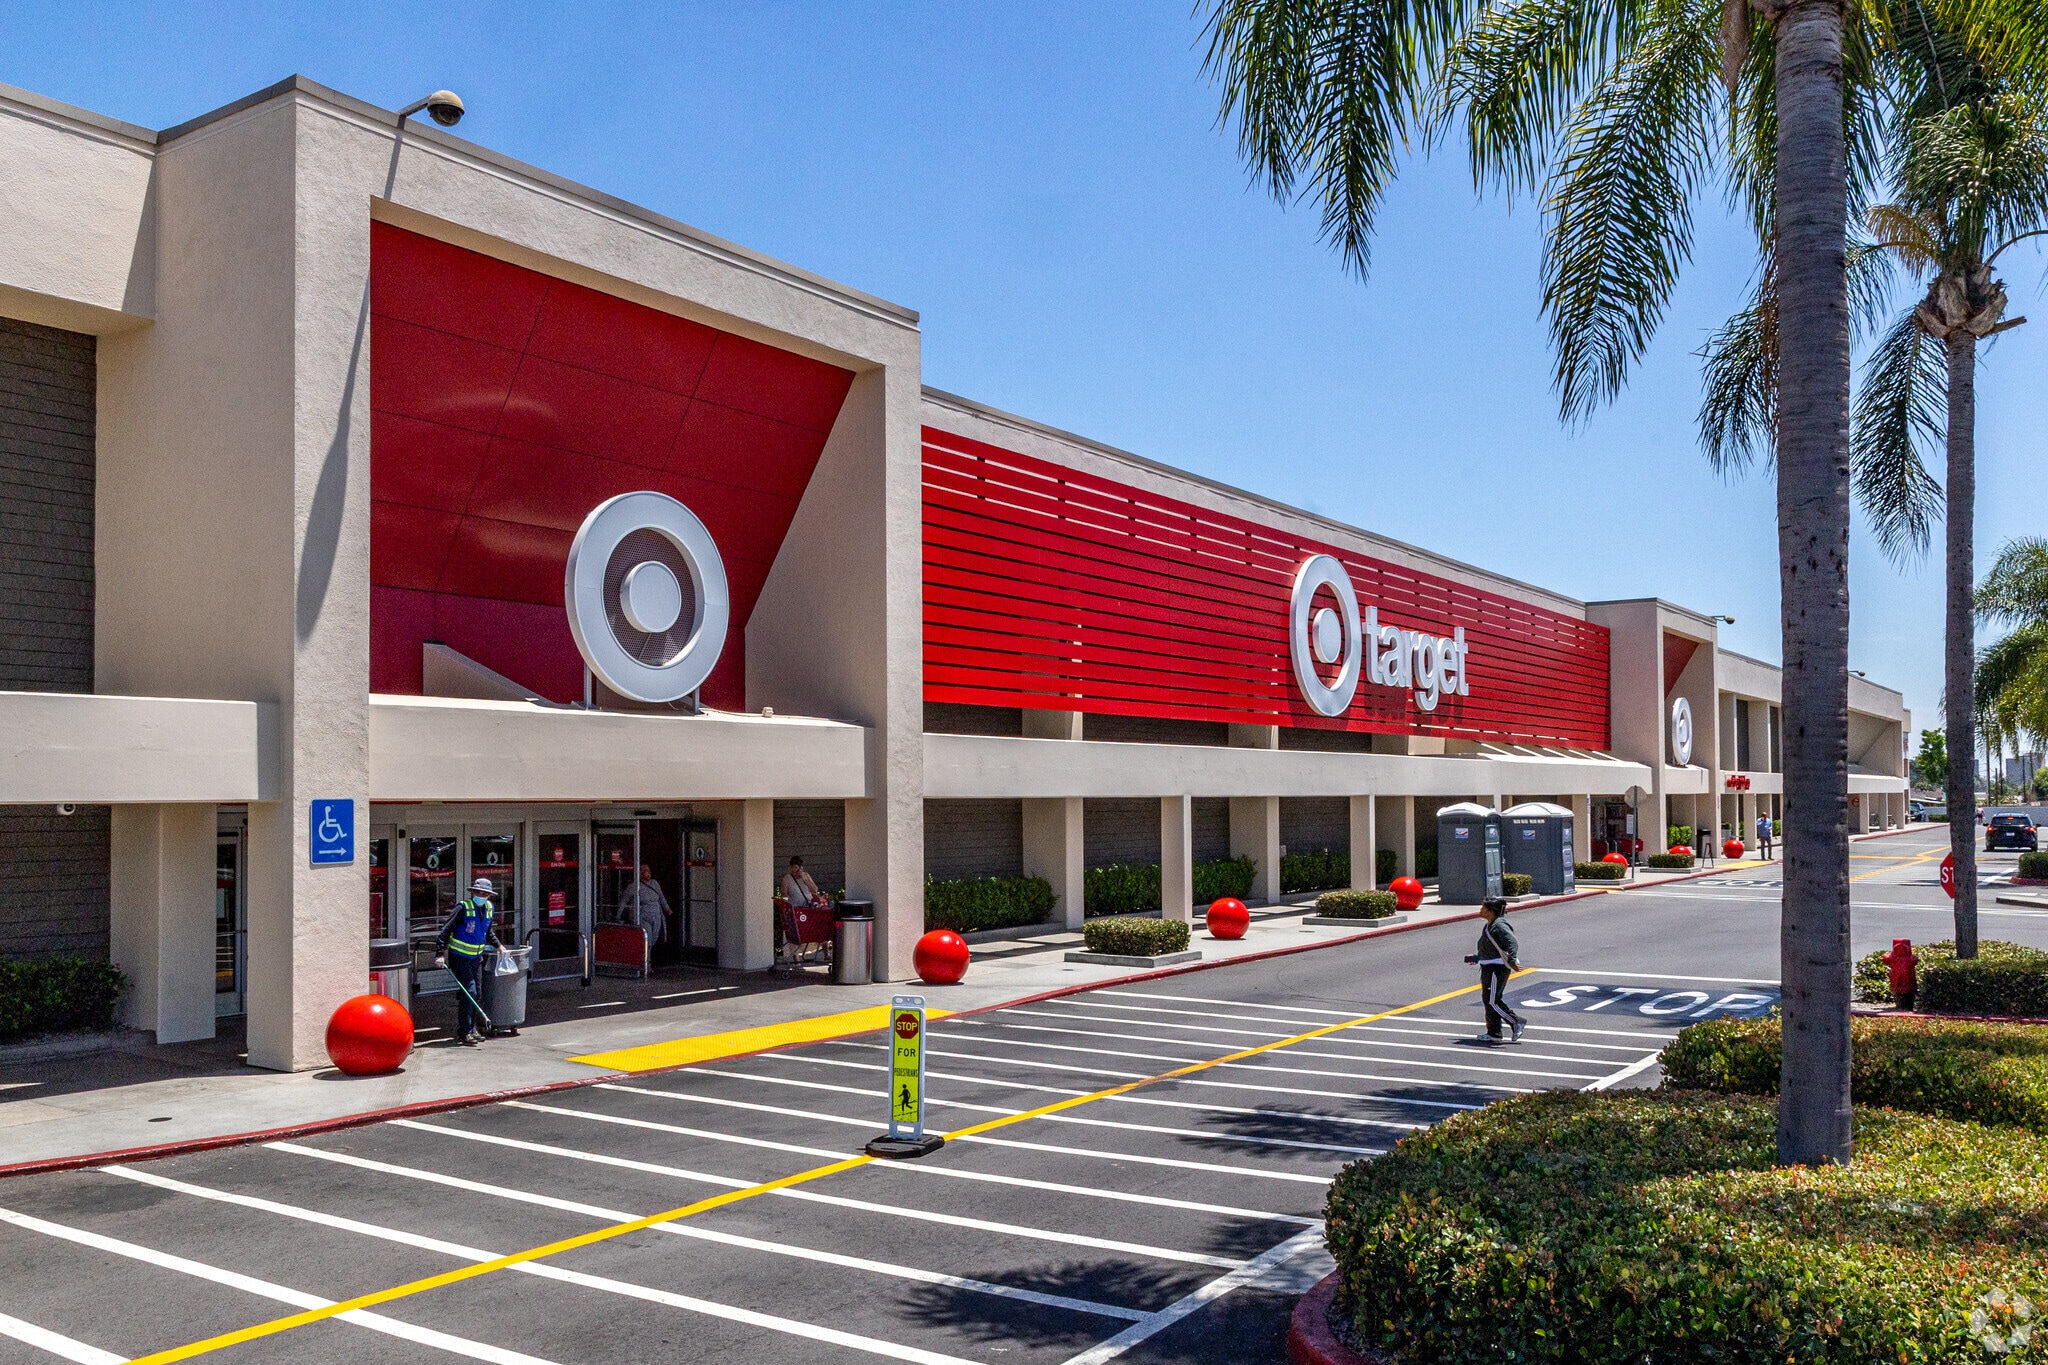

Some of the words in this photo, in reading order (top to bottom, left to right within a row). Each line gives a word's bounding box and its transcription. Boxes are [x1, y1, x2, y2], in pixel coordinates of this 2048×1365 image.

[1362, 605, 1469, 711] target
[1941, 867, 1954, 883] ST
[1520, 985, 1774, 1018] STOP
[896, 1021, 917, 1031] STOP
[897, 1047, 916, 1057] FOR
[894, 1067, 918, 1077] PEDESTRIANS
